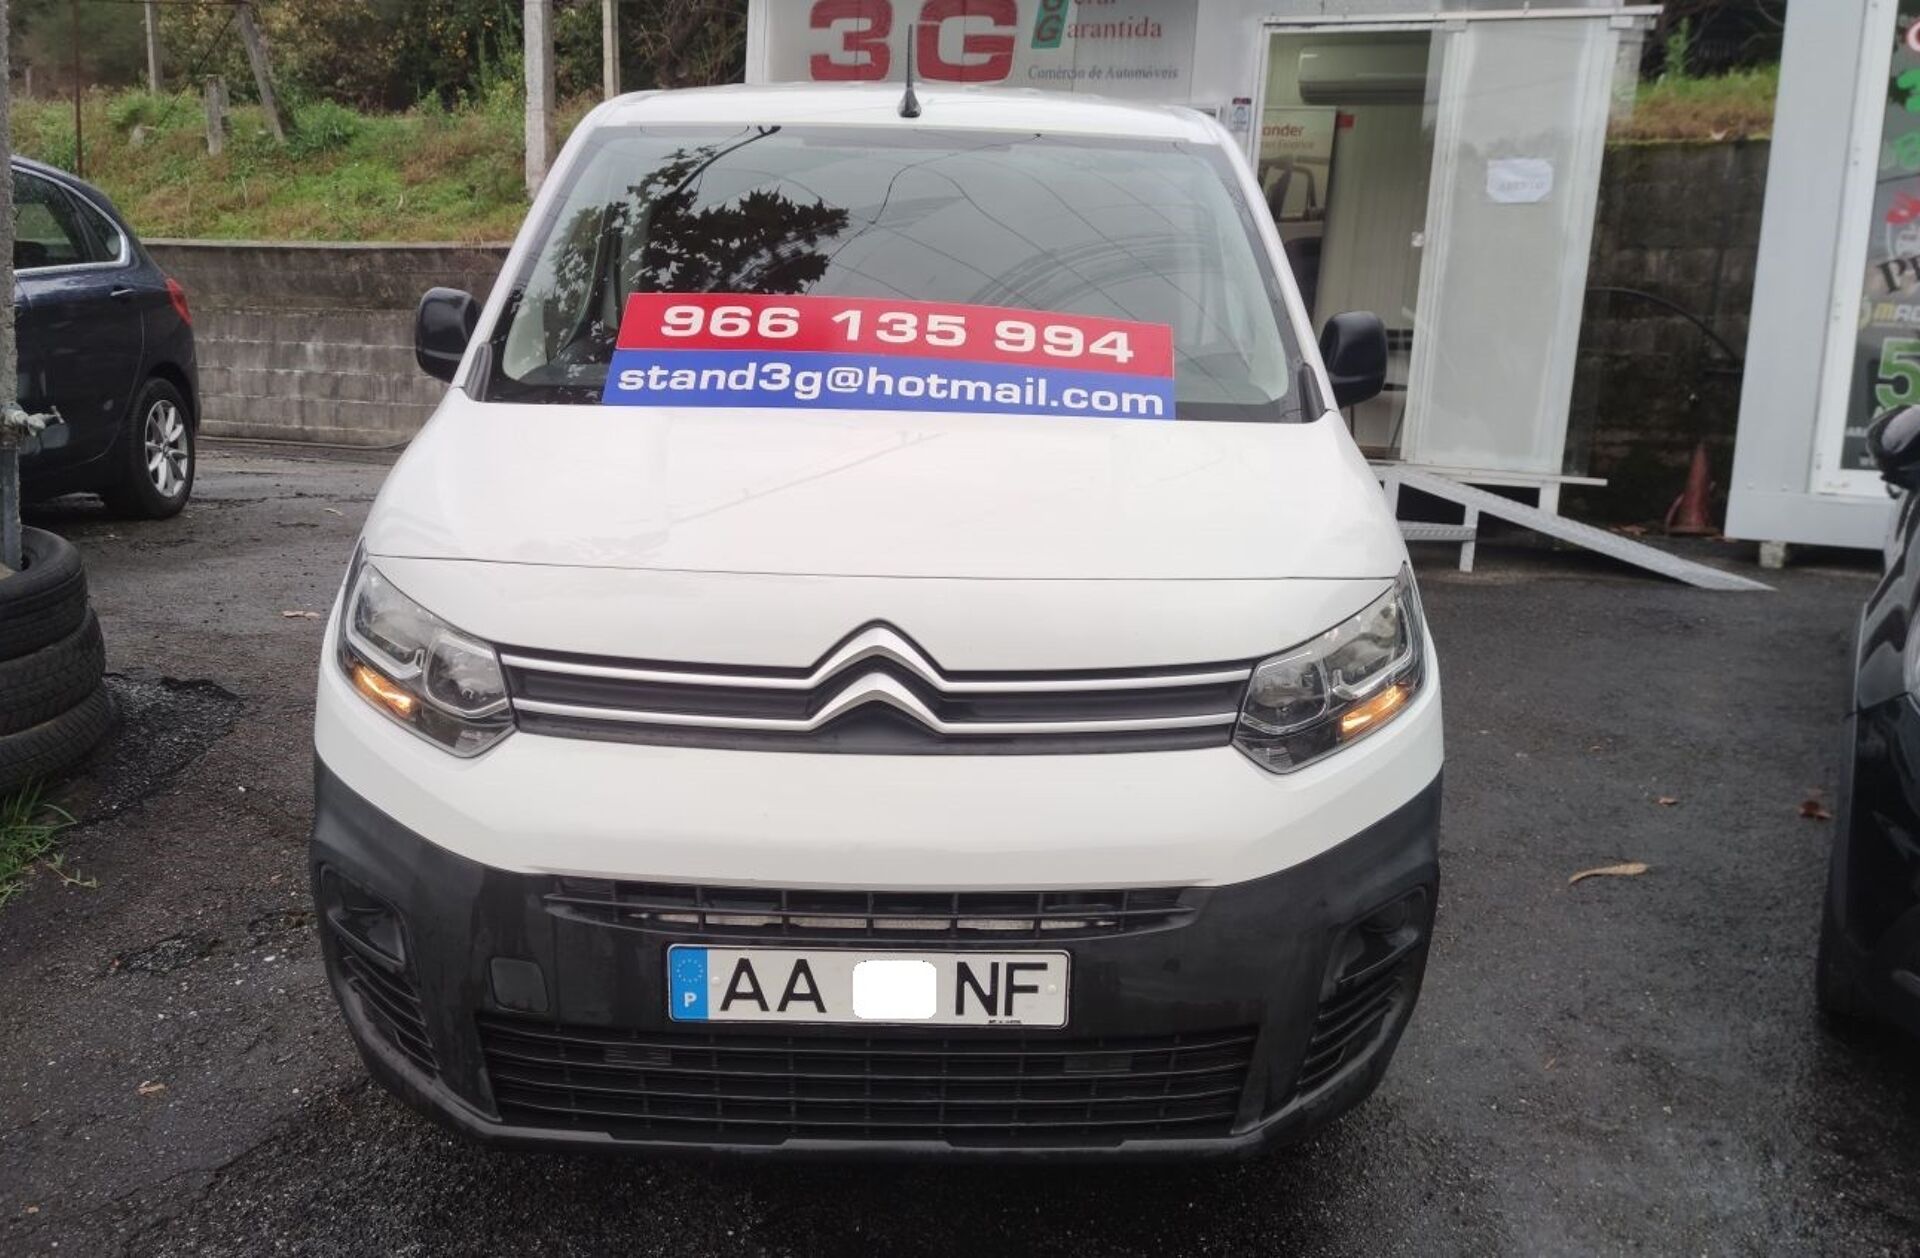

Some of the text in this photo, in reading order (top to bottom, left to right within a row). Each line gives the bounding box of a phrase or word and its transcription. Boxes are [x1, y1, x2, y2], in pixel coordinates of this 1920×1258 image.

[809, 0, 1018, 83] 3G
[1037, 14, 1162, 42] Garantida
[1088, 65, 1103, 79] de
[660, 305, 1135, 364] 966 135 994
[617, 362, 1164, 416] stand3g@hotmail.com
[684, 992, 698, 1008] P
[720, 957, 1048, 1017] AA NF
